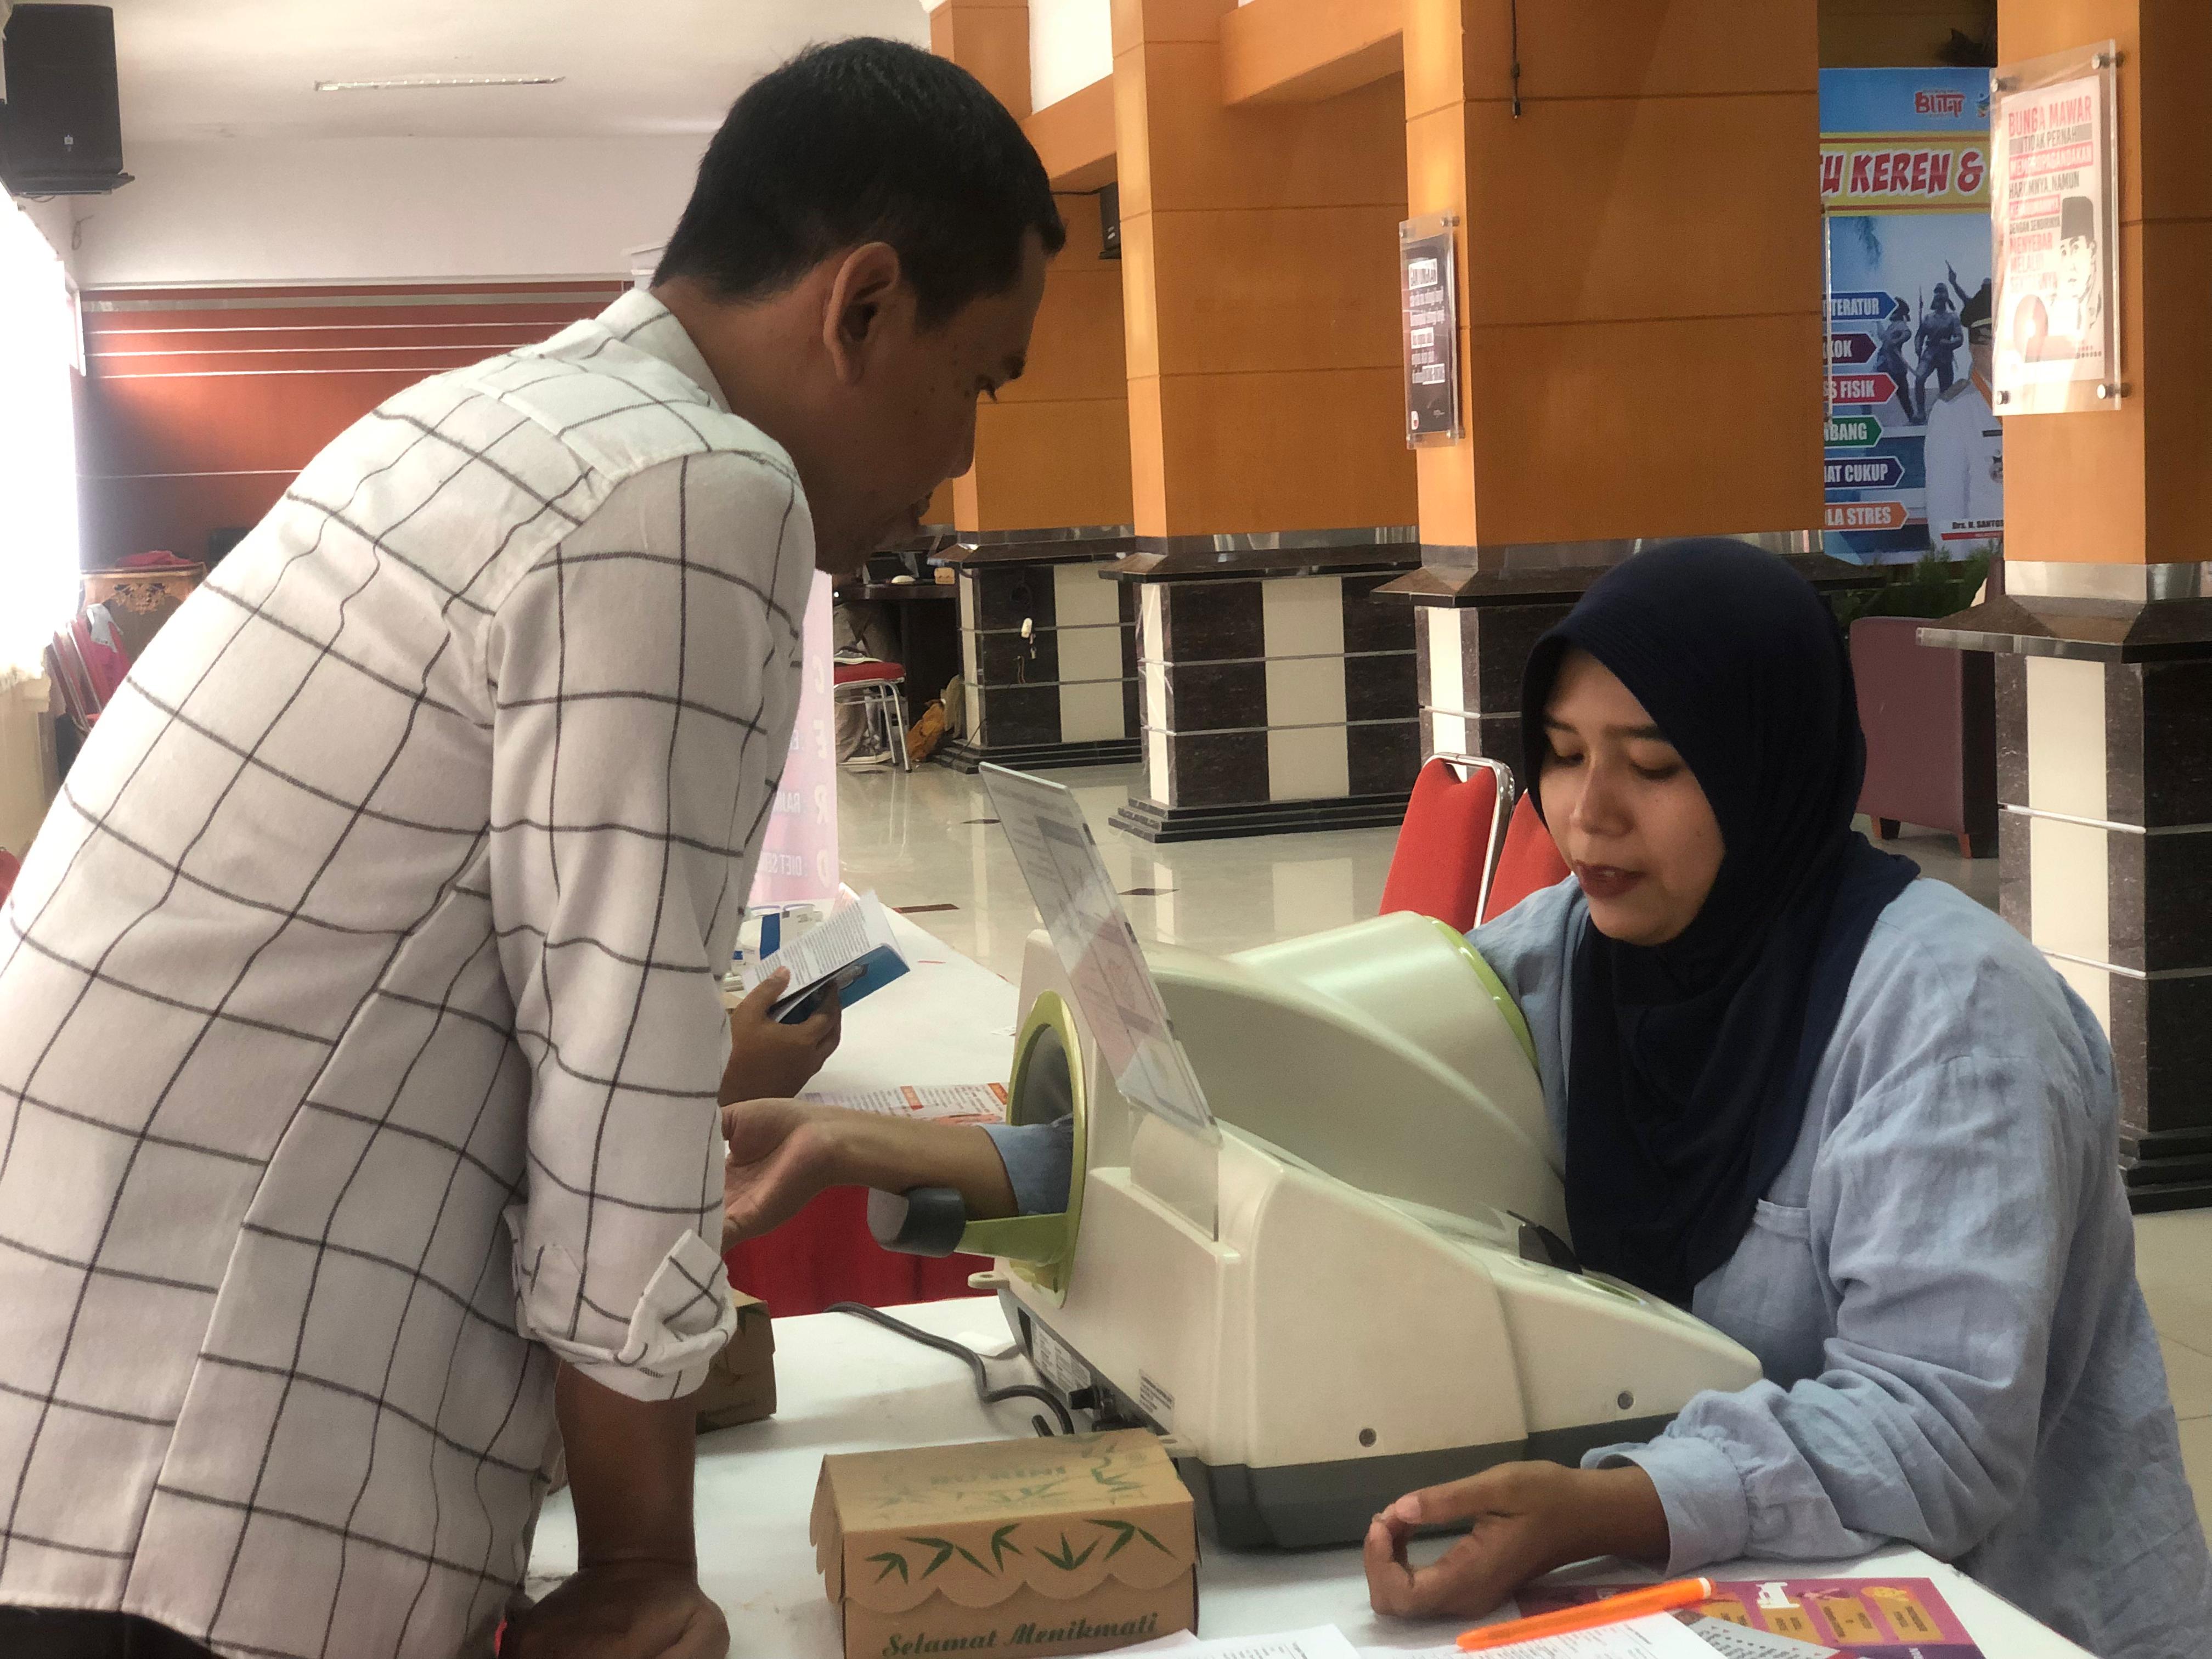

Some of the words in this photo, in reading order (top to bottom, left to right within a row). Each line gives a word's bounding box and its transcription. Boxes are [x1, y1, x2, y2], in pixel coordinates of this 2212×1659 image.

[2008, 106, 2045, 137] BUNGA
[2049, 95, 2092, 129] MAWAR
[2023, 132, 2045, 153] TIDAK
[2046, 126, 2077, 148] PERNAH
[1820, 154, 1844, 193] U
[1850, 152, 1951, 194] KEREN
[1957, 151, 1984, 193] &
[1831, 298, 1879, 316] TERATUR
[1840, 380, 1875, 398] FISIK
[1845, 463, 1888, 482] CUKUP
[1847, 506, 1892, 525] STRES
[883, 1630, 997, 1657] Selamat
[1005, 1612, 1158, 1645] Menikmati
